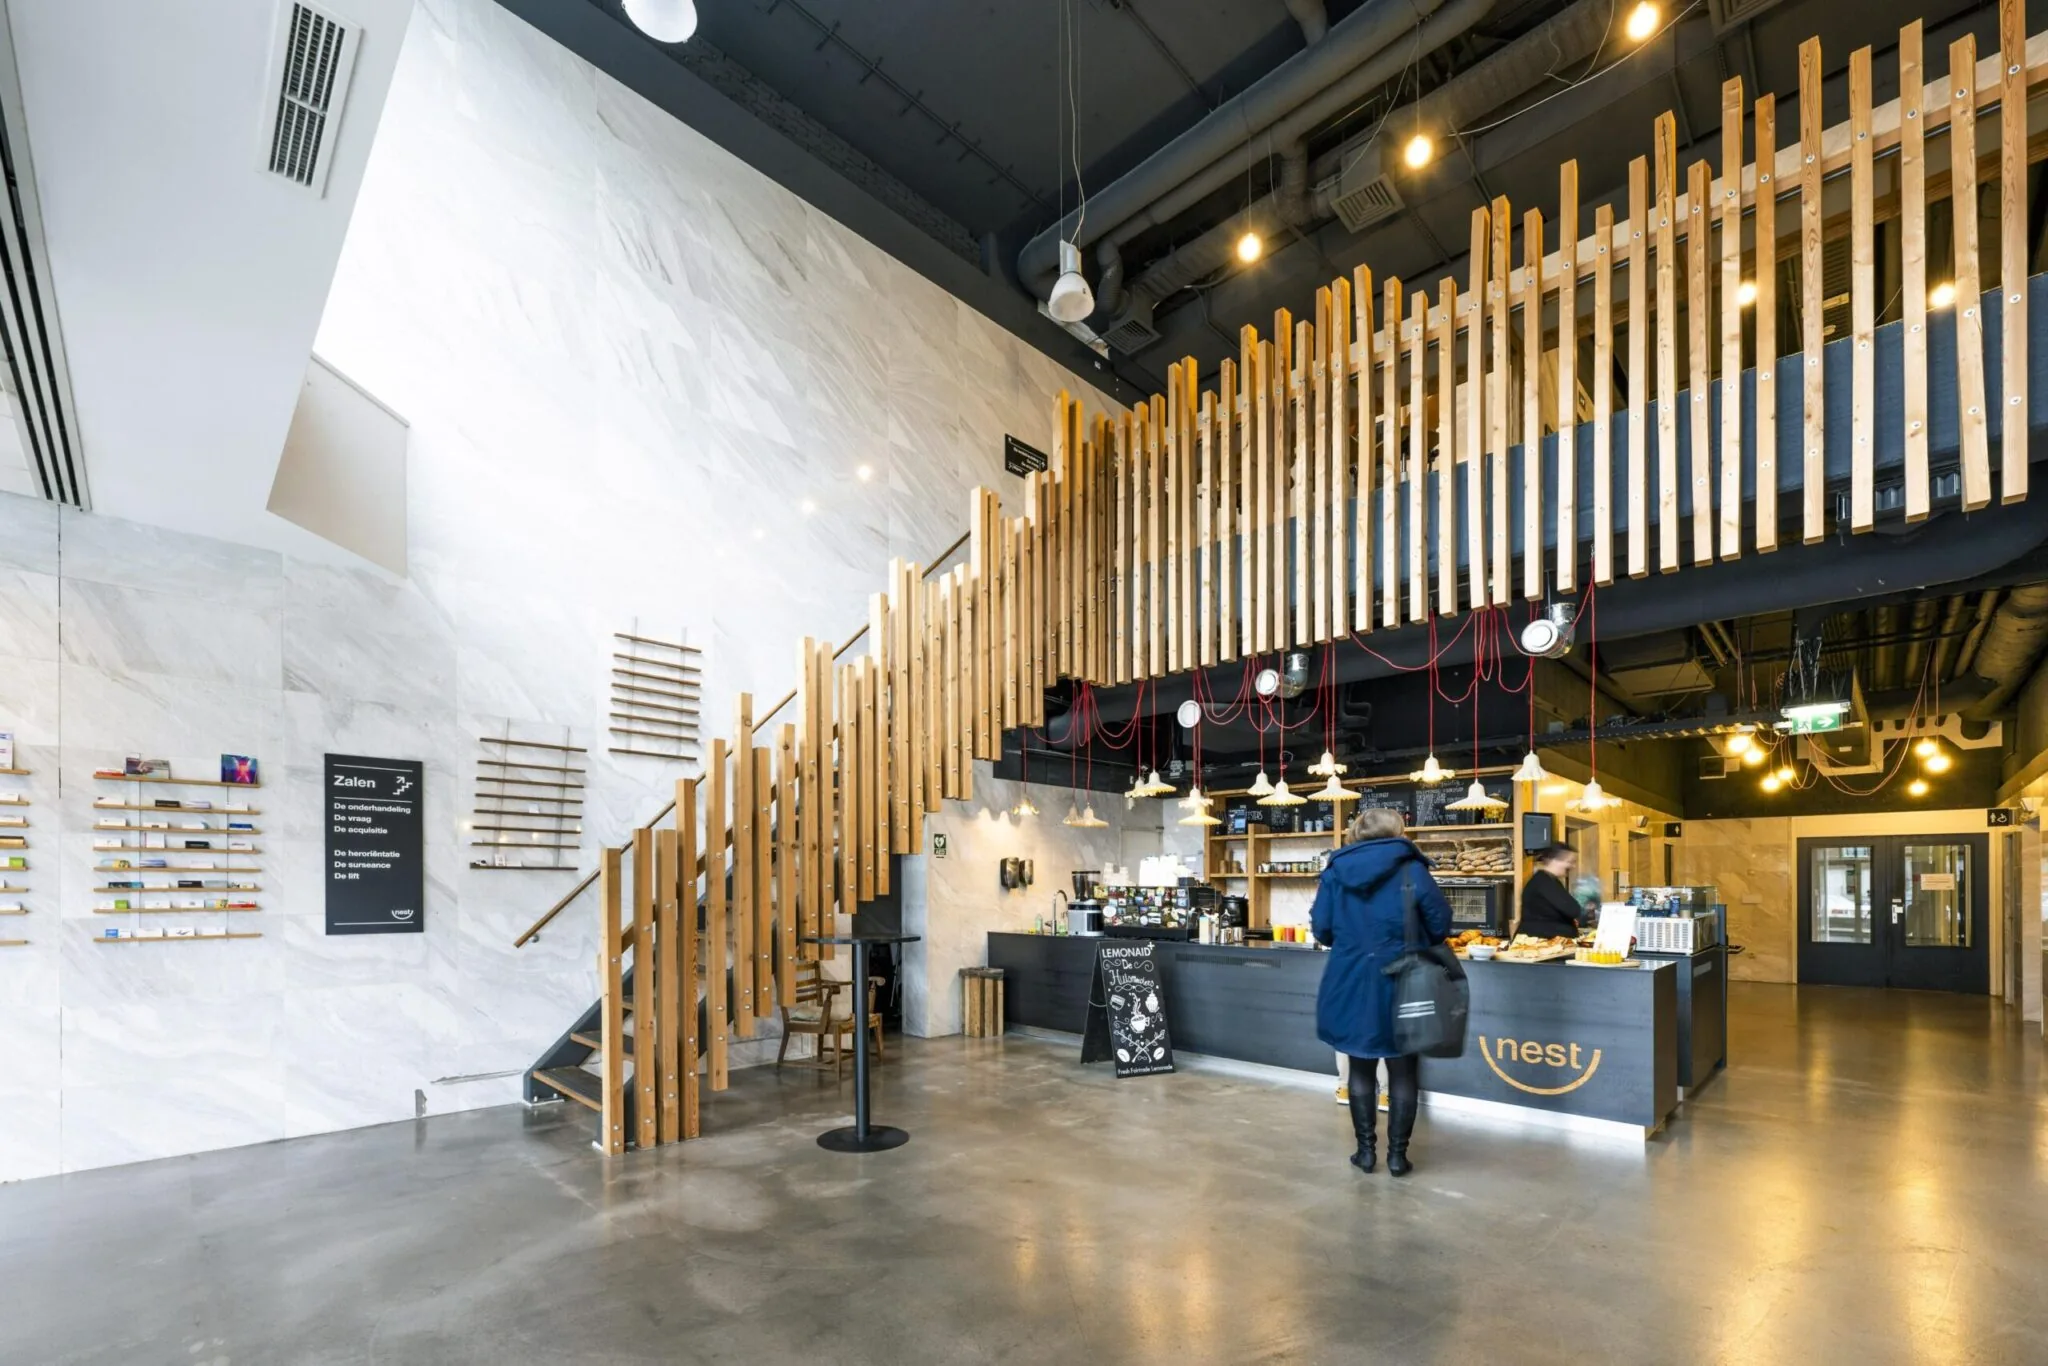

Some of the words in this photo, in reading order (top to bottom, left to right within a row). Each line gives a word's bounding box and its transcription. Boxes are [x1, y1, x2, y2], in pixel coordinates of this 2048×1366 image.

[333, 775, 376, 788] Zalen
[334, 802, 346, 810] De
[348, 804, 411, 814] onderhandeling
[1121, 959, 1133, 970] De
[1496, 1037, 1582, 1070] nest
